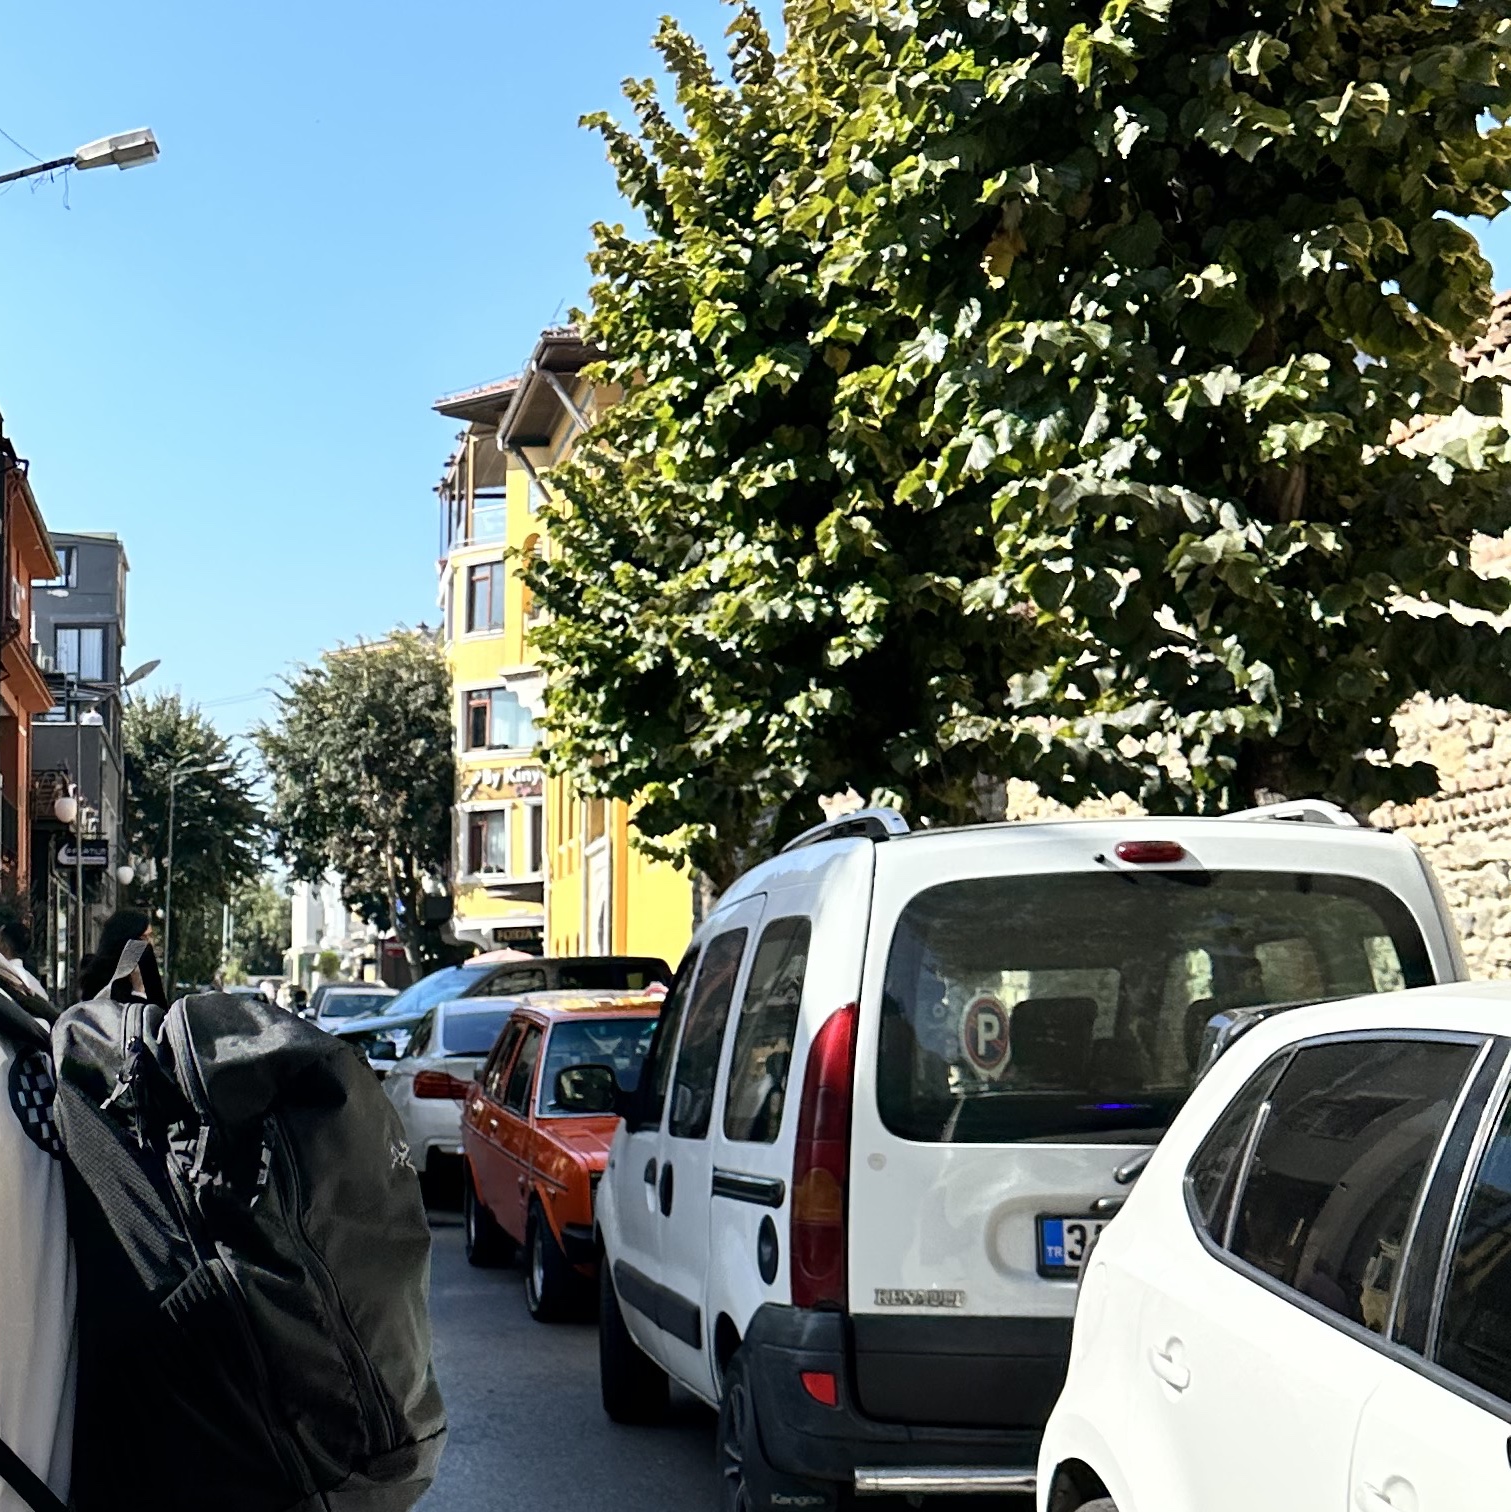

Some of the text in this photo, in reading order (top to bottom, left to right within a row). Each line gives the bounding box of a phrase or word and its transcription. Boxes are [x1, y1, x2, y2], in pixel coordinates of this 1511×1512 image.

[977, 1012, 1000, 1056] P
[1046, 1223, 1103, 1261] TR 3
